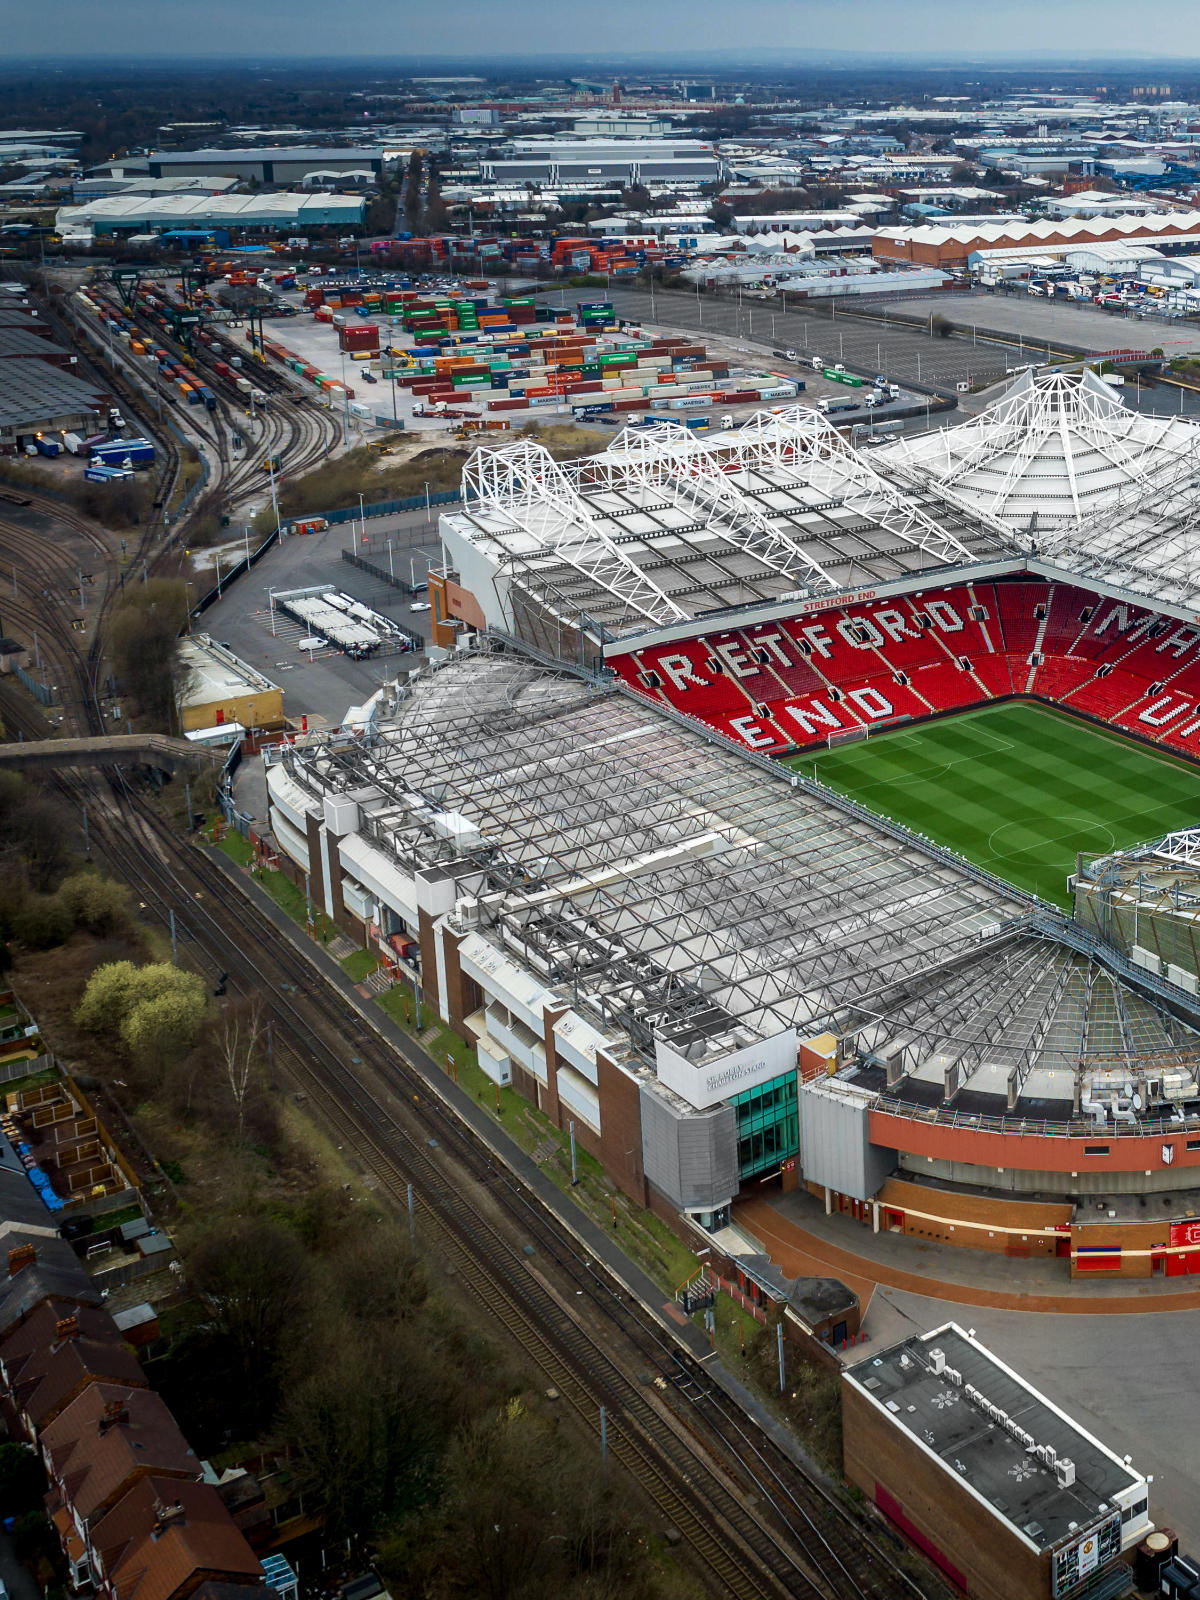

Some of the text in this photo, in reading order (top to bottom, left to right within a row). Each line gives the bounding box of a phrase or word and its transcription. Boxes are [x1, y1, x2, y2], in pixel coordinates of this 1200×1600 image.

[803, 590, 876, 612] STRETFORD END
[728, 686, 894, 749] END
[745, 1061, 767, 1075] STAND
